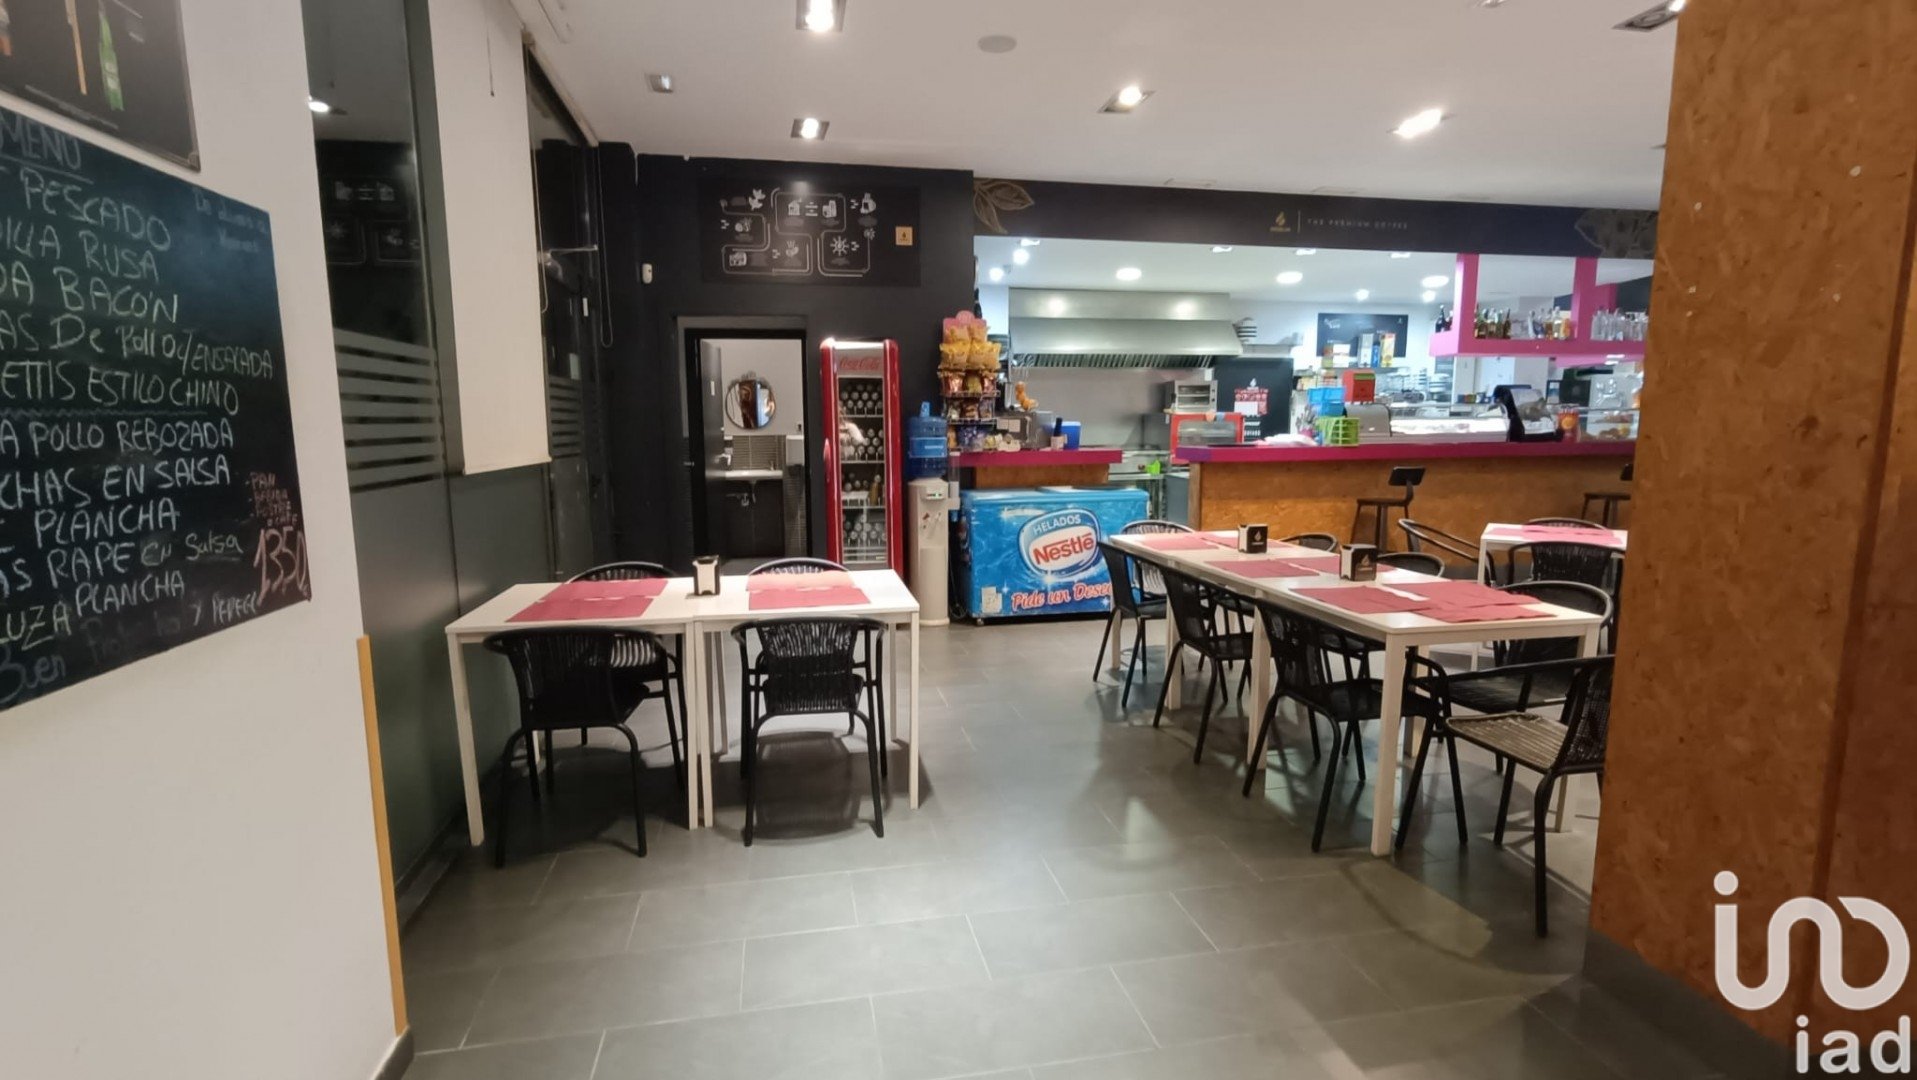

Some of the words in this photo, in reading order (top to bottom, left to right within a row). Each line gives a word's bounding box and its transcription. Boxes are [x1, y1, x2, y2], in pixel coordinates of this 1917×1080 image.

[20, 167, 171, 251] PESCADO
[0, 217, 60, 260] ILLA
[79, 229, 160, 284] RUSA
[1, 359, 76, 401] ETTIS
[88, 365, 164, 407] ESTILO
[169, 377, 239, 416] CHINO
[28, 421, 104, 457] POLLO
[116, 417, 234, 455] REBOZADA
[102, 463, 145, 500] EN
[154, 454, 230, 489] SALSA
[34, 497, 181, 549] PLANCHA
[1033, 514, 1082, 535] HELADOS
[47, 542, 135, 588] RAPE
[1032, 533, 1094, 565] Nestlé
[75, 570, 185, 617] PLANCHA
[1011, 590, 1045, 612] Pide
[1047, 588, 1070, 604] un
